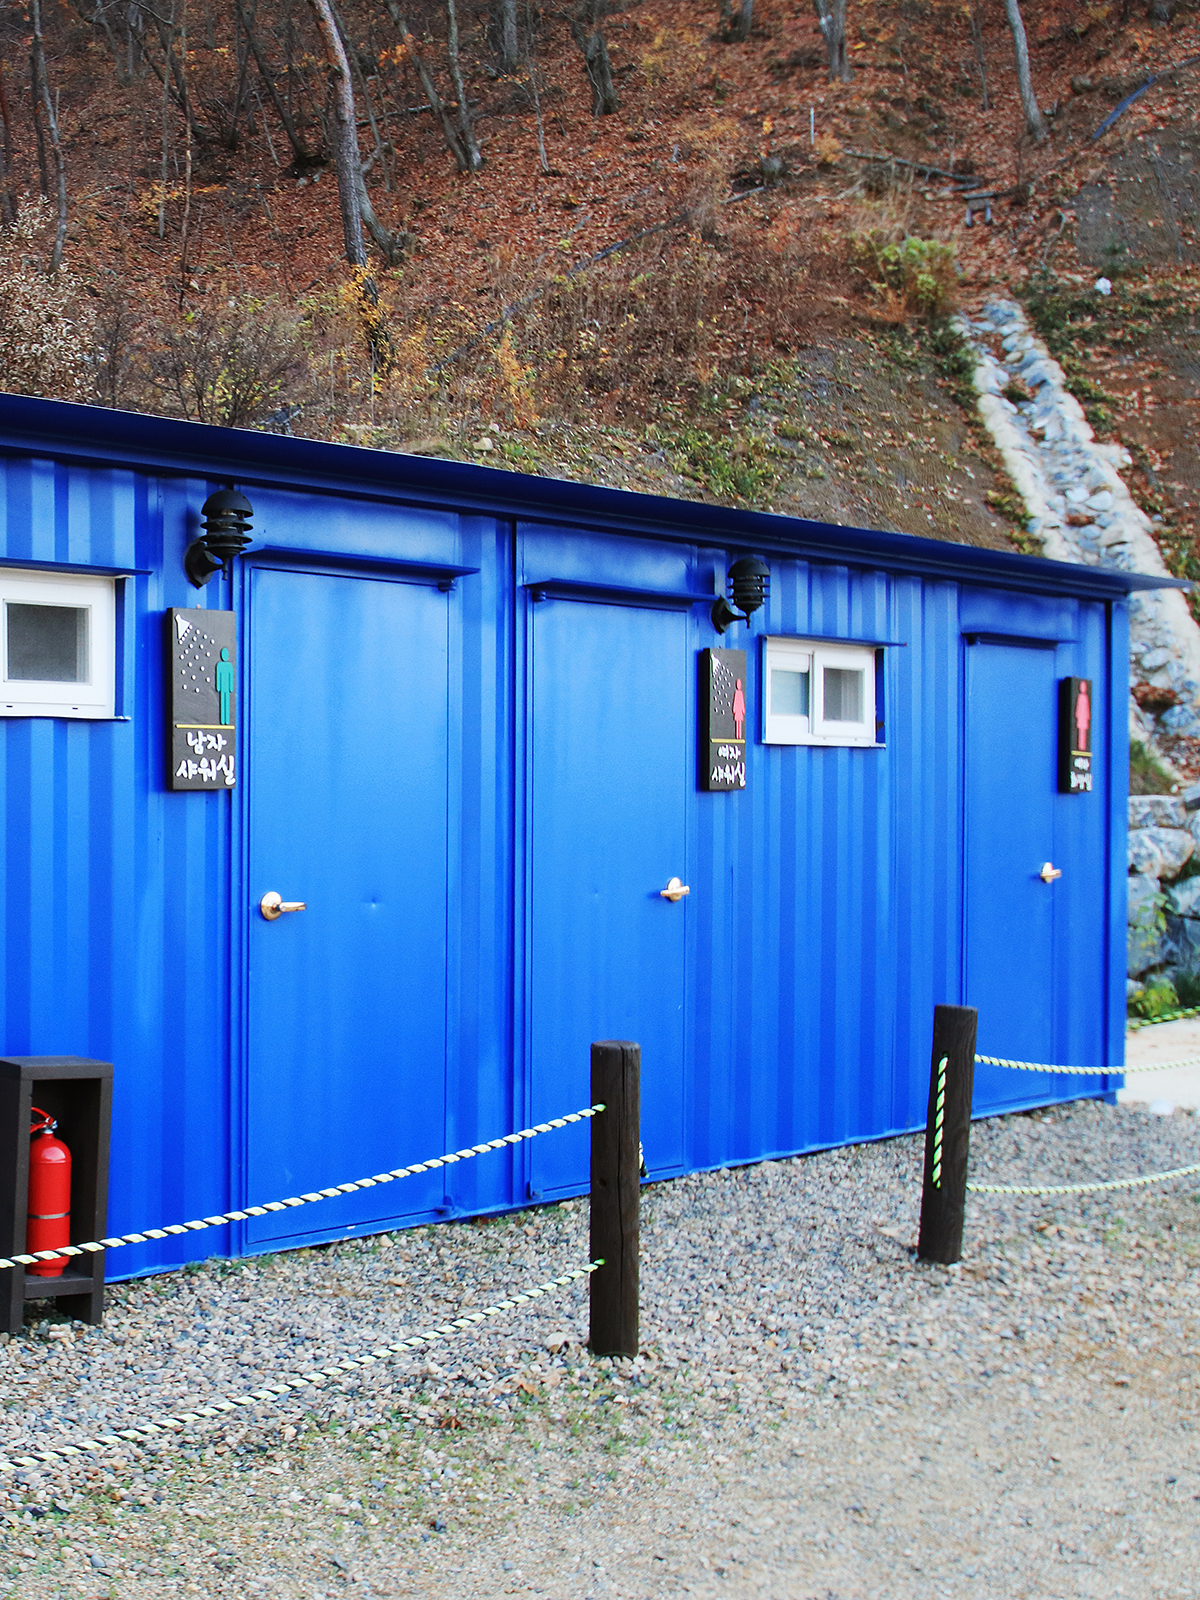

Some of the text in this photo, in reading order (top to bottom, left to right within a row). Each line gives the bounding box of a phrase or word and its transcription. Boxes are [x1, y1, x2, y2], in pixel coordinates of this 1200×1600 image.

[186, 730, 227, 755] 남자
[176, 754, 236, 786] 샤워실
[711, 761, 745, 788] 샤워실
